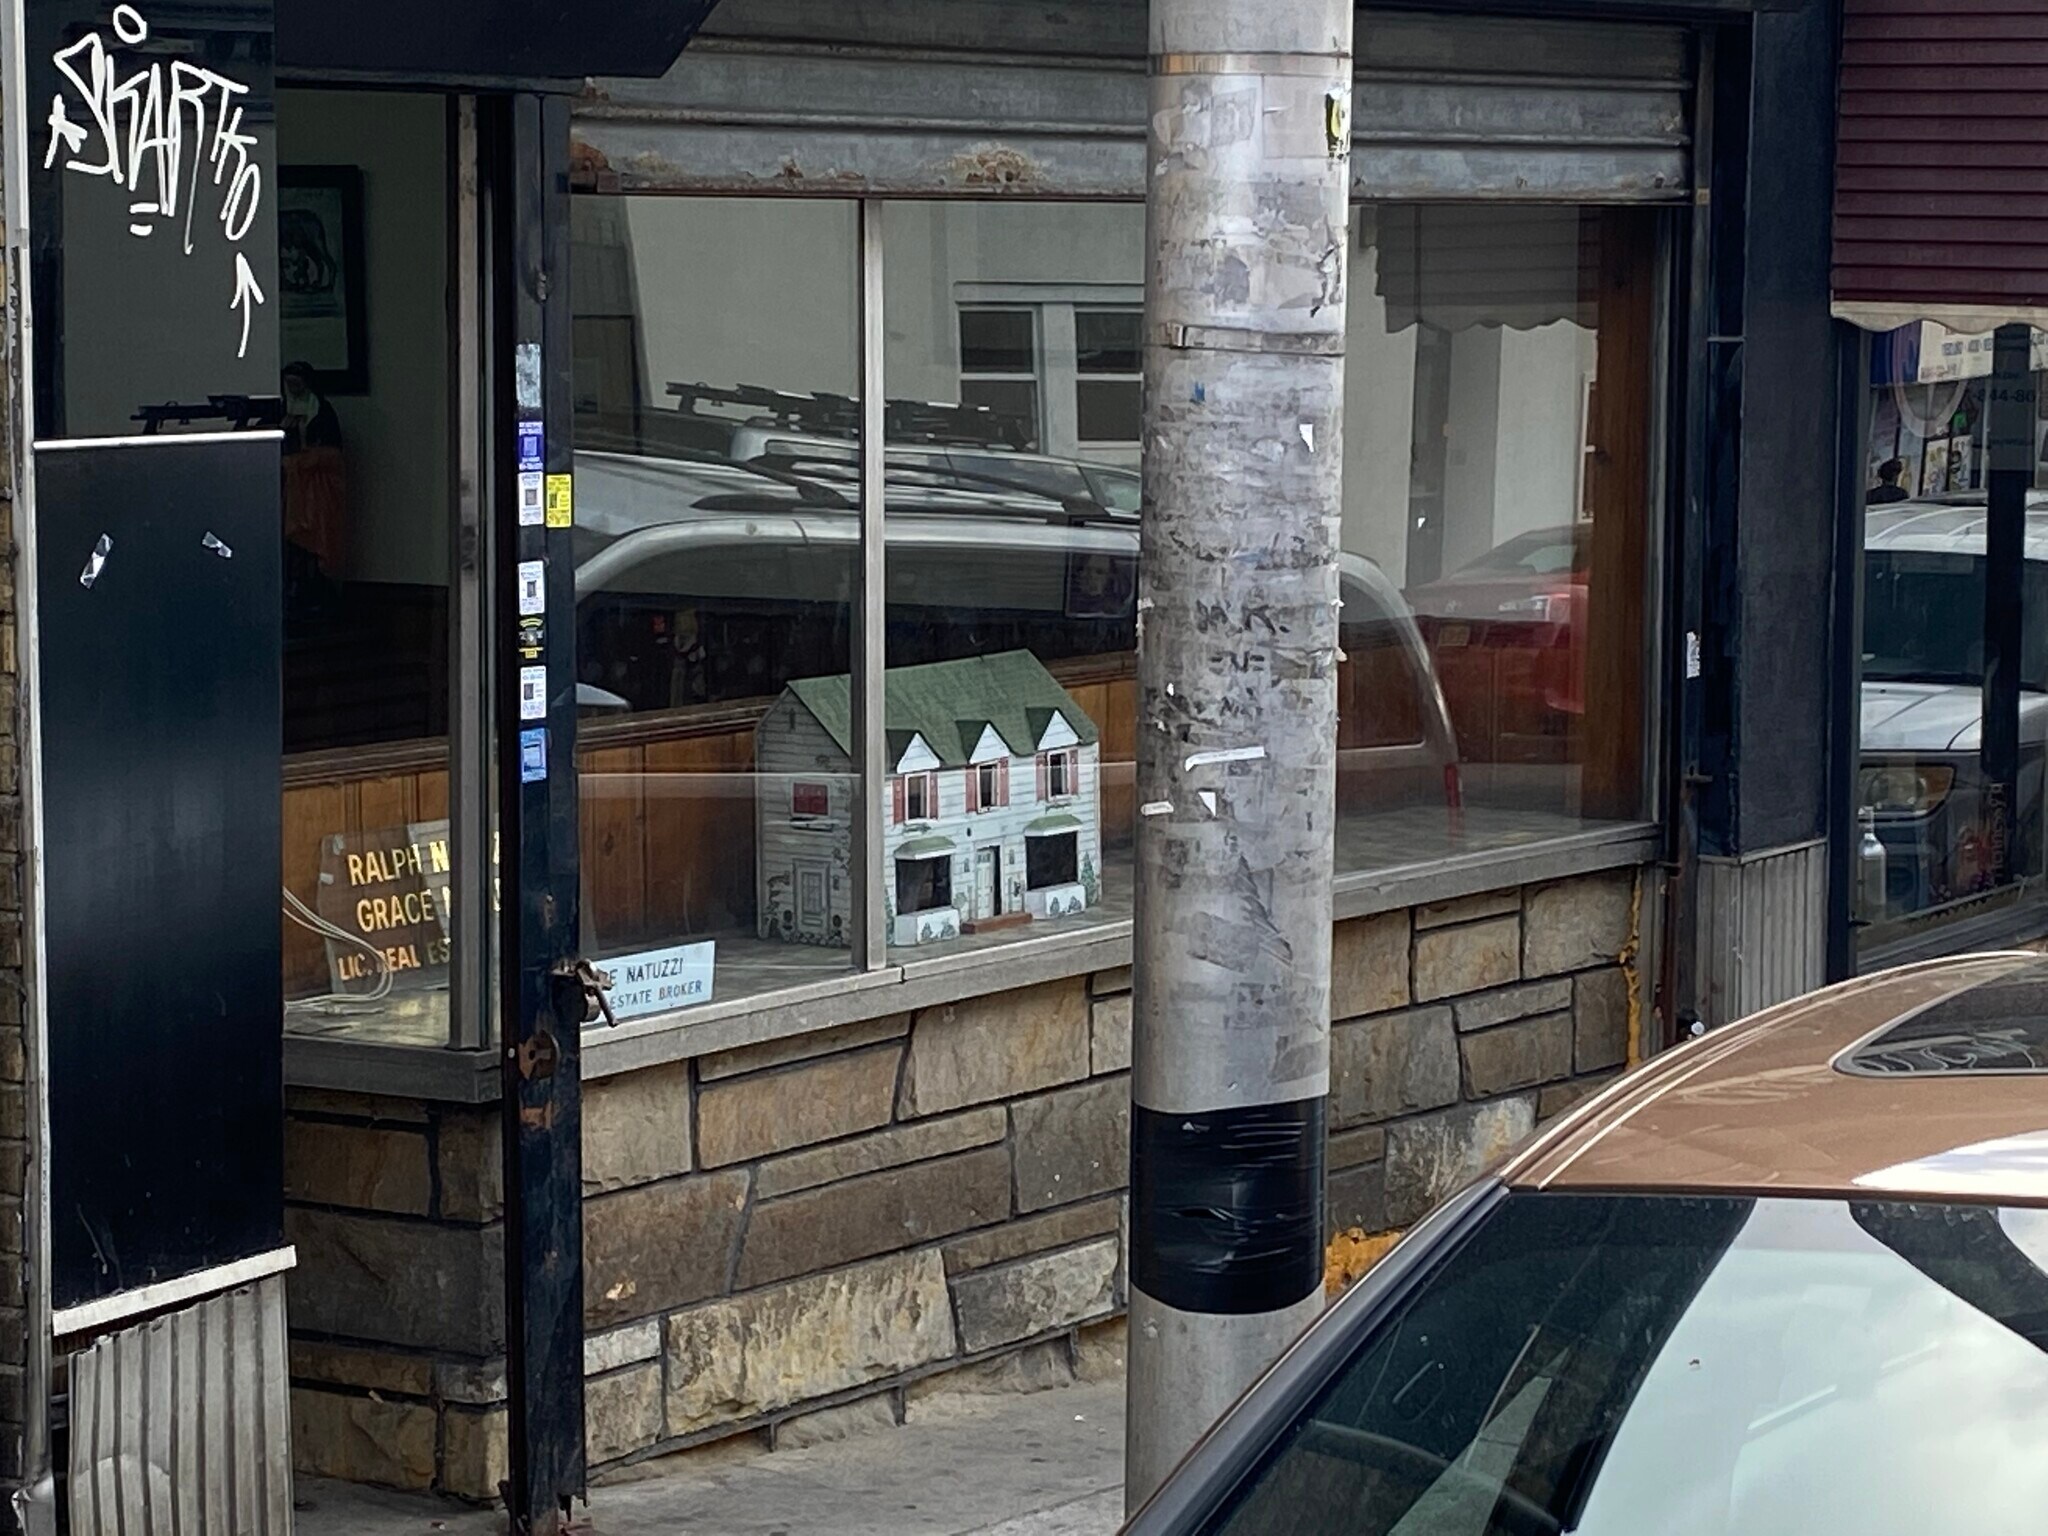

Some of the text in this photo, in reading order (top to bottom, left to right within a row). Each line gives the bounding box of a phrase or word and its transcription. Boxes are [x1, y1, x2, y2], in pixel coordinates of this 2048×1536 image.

[348, 844, 421, 886] RALPH
[357, 888, 434, 933] GRACE
[338, 952, 373, 981] LIC.
[626, 957, 684, 984] NATUZZI
[609, 979, 702, 1010] ESTATE BROKER
